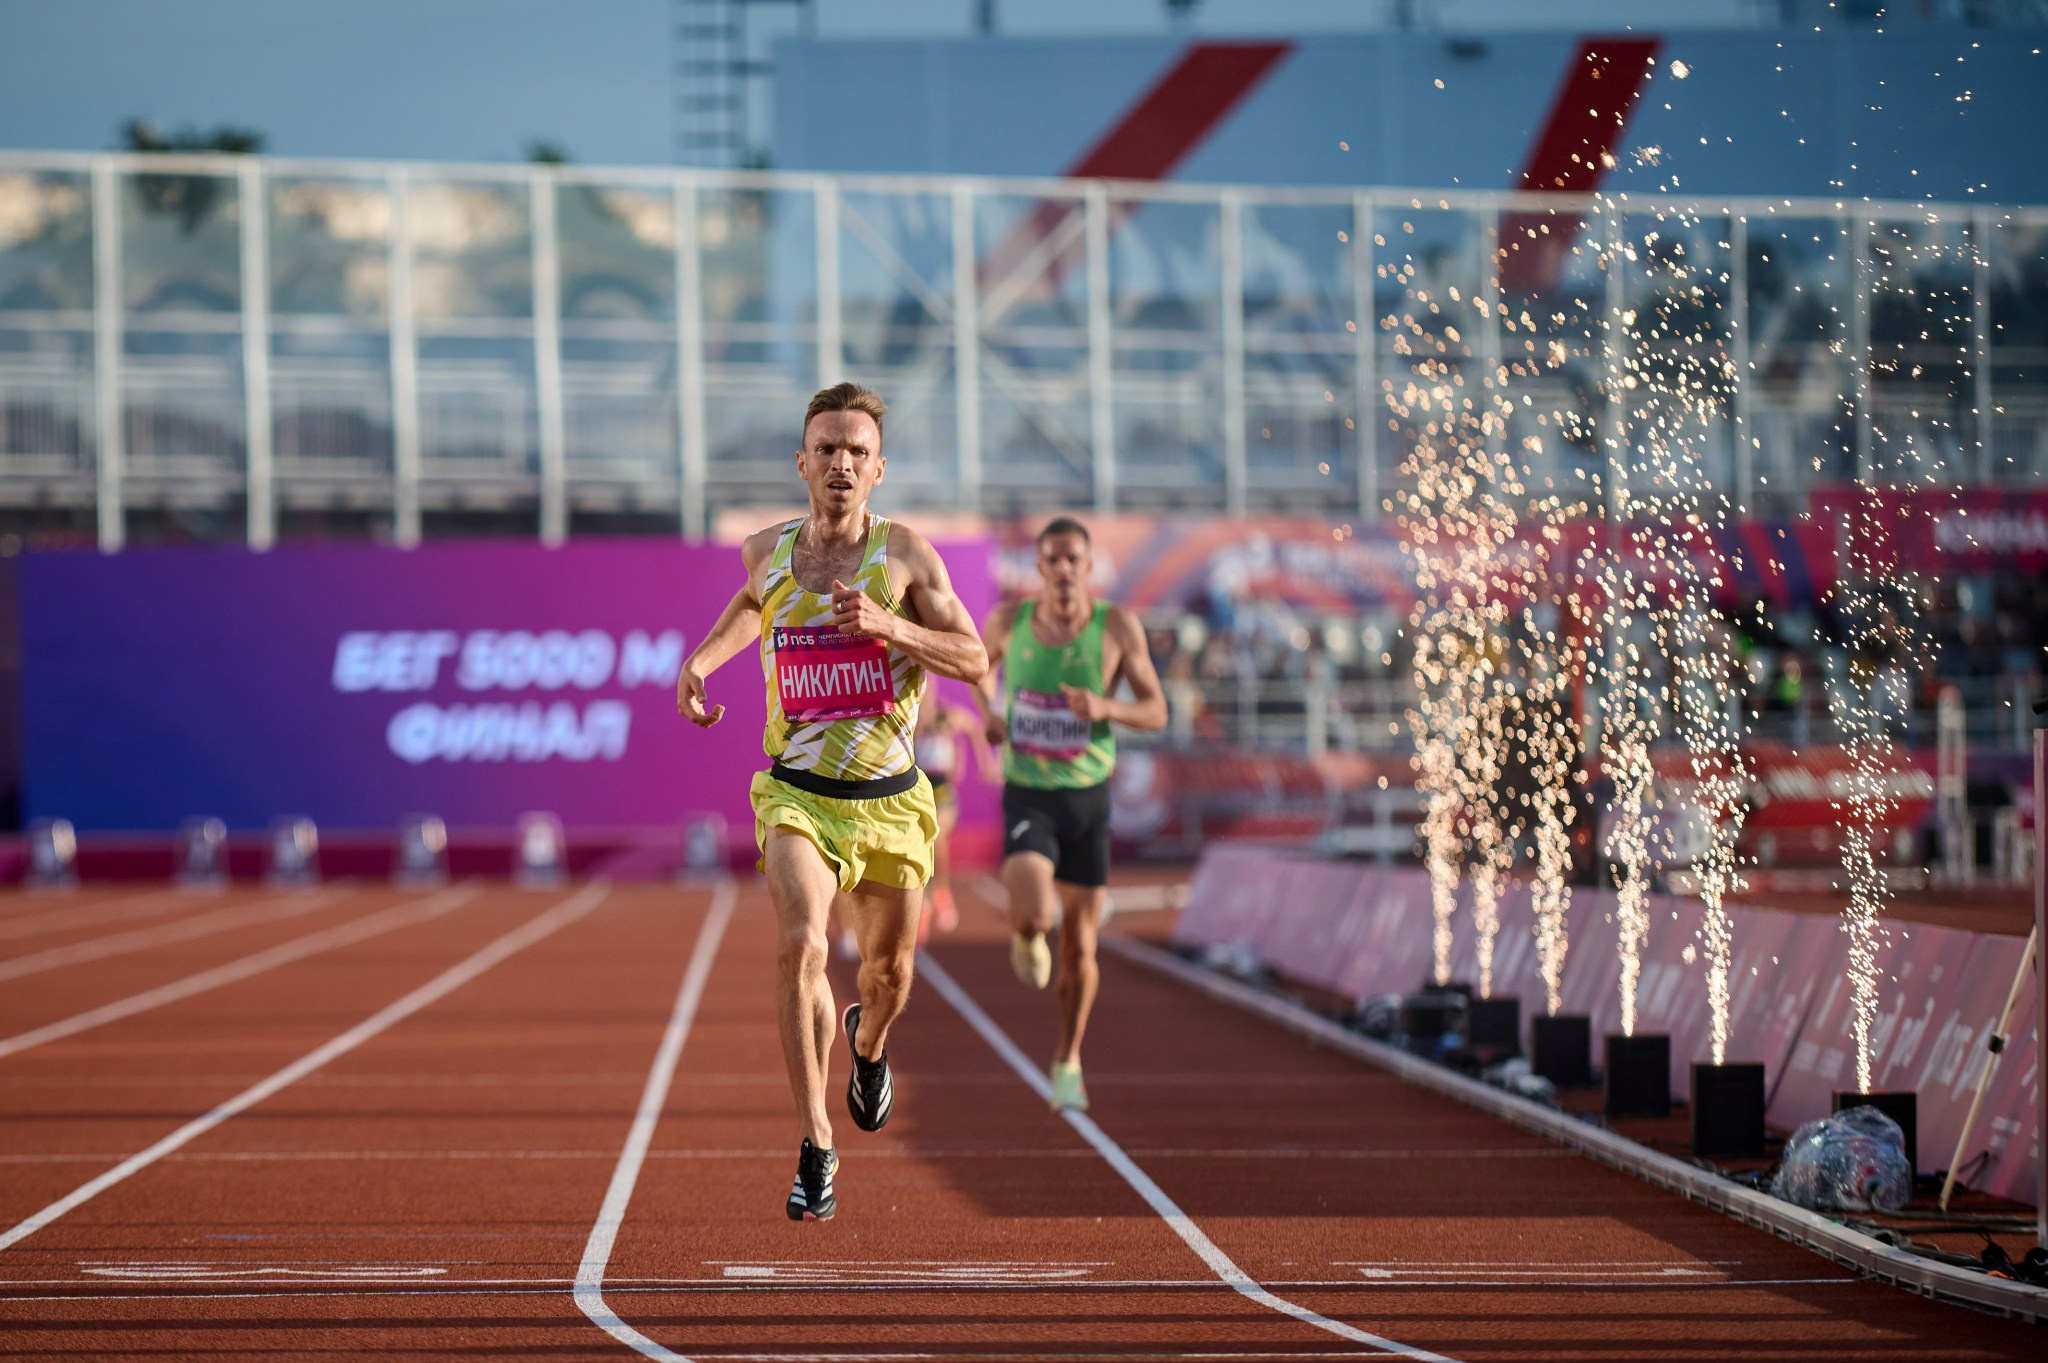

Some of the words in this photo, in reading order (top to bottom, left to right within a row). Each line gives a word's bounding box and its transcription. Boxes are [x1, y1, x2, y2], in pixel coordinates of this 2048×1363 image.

[334, 632, 457, 691] БЕГ
[458, 630, 615, 690] 5000
[619, 630, 684, 688] М
[790, 635, 815, 646] ПСБ
[781, 658, 887, 699] НИКИТИН
[388, 701, 630, 763] ФИНАЛ
